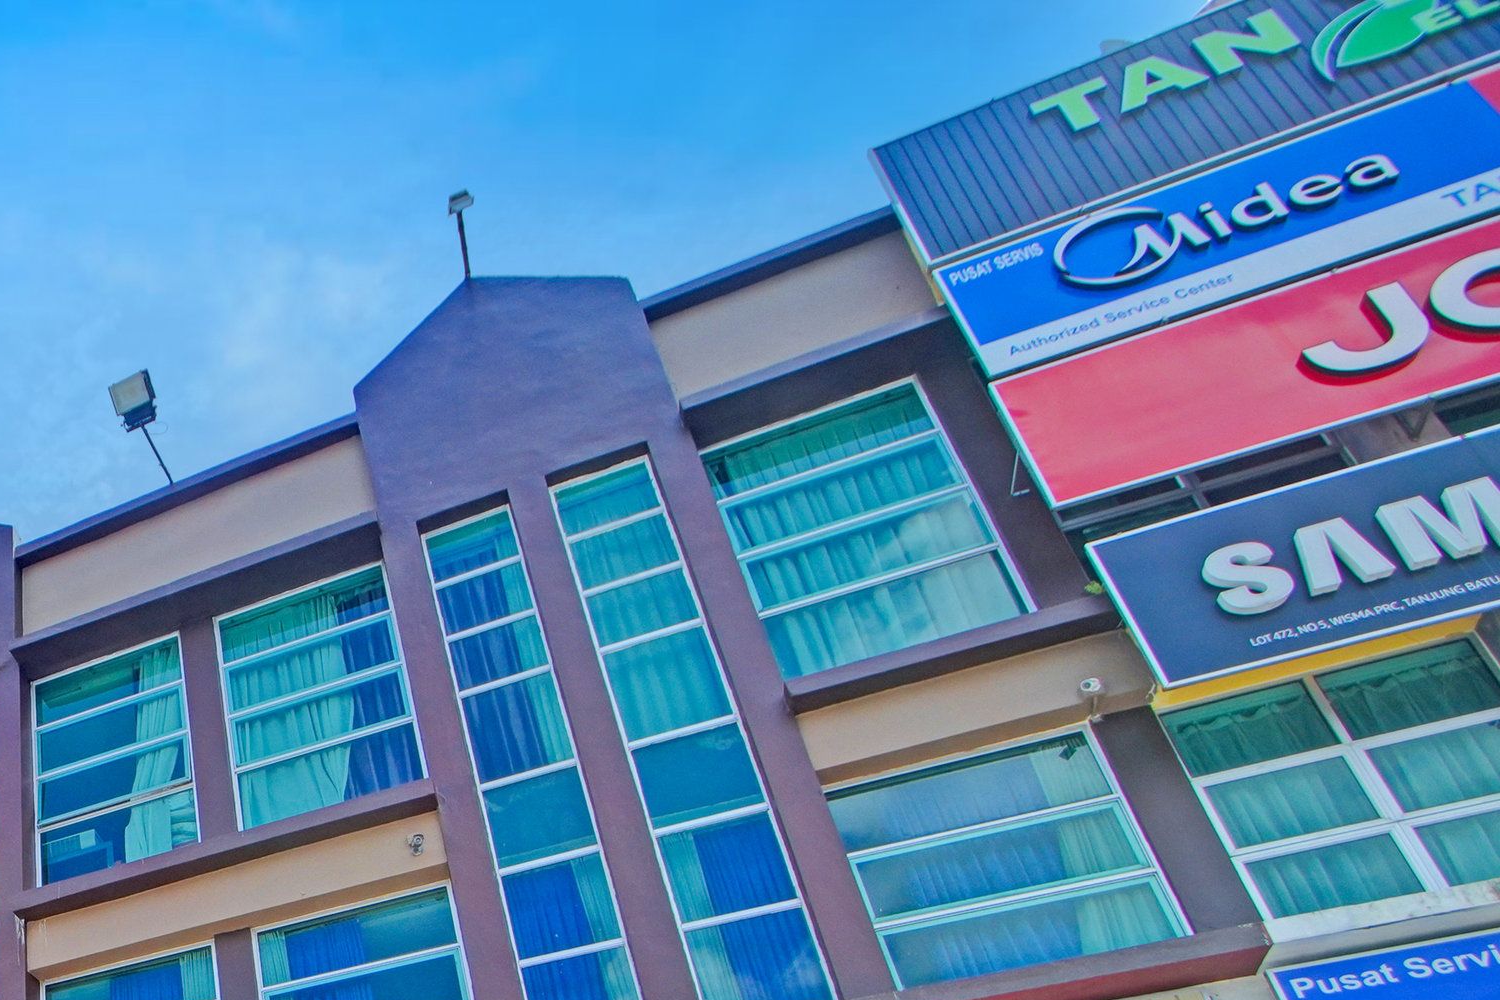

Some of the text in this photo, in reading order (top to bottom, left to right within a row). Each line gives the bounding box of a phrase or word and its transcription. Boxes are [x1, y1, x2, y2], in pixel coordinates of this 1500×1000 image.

[1029, 8, 1301, 132] TAN
[1112, 153, 1400, 278] Midea
[949, 242, 1045, 287] PUSAT SERVIS
[1009, 272, 1235, 356] Authorized Service Center
[1250, 631, 1273, 647] LOT
[1273, 627, 1299, 641] 472,
[1298, 621, 1318, 635] NO
[1329, 606, 1376, 627] WISMA
[1374, 600, 1405, 616] PRC,
[1402, 584, 1465, 608] TANJUNG
[1289, 963, 1400, 999] Pusat
